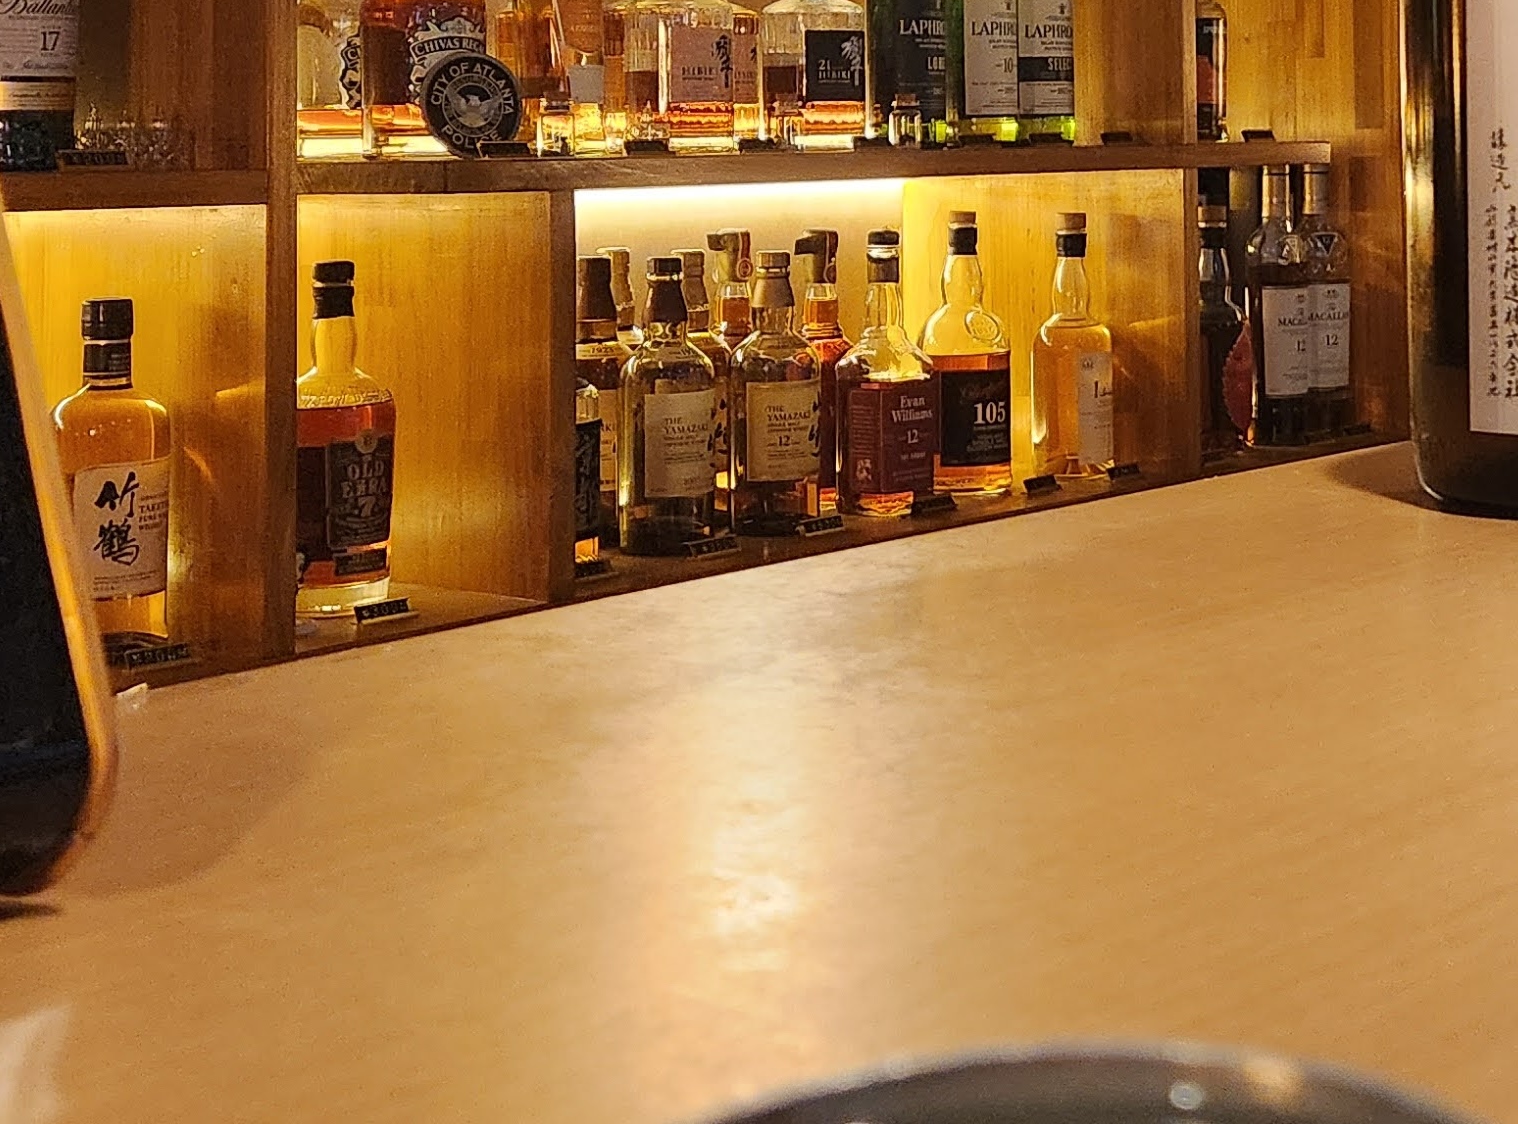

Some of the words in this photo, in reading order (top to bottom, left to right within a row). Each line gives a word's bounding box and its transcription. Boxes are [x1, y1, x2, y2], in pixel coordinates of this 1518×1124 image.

[41, 31, 60, 50] 17
[415, 38, 460, 57] CHIVAS
[818, 59, 831, 70] 21
[1003, 58, 1014, 74] 10
[818, 70, 850, 80] HIBIKI
[431, 75, 448, 105] CITY
[449, 62, 470, 77] OF
[473, 63, 514, 115] ATLANTA
[1325, 334, 1339, 347] 12
[767, 405, 785, 413] THE
[900, 395, 925, 408] Evan
[766, 410, 810, 422] YAMAZAKI
[891, 408, 933, 423] Williams
[973, 401, 1006, 425] 105
[665, 417, 682, 425] THE
[778, 435, 791, 447] 12
[907, 429, 919, 444] 12
[346, 461, 385, 480] OLD
[357, 496, 376, 517] 7
[94, 471, 140, 566] 竹鶴
